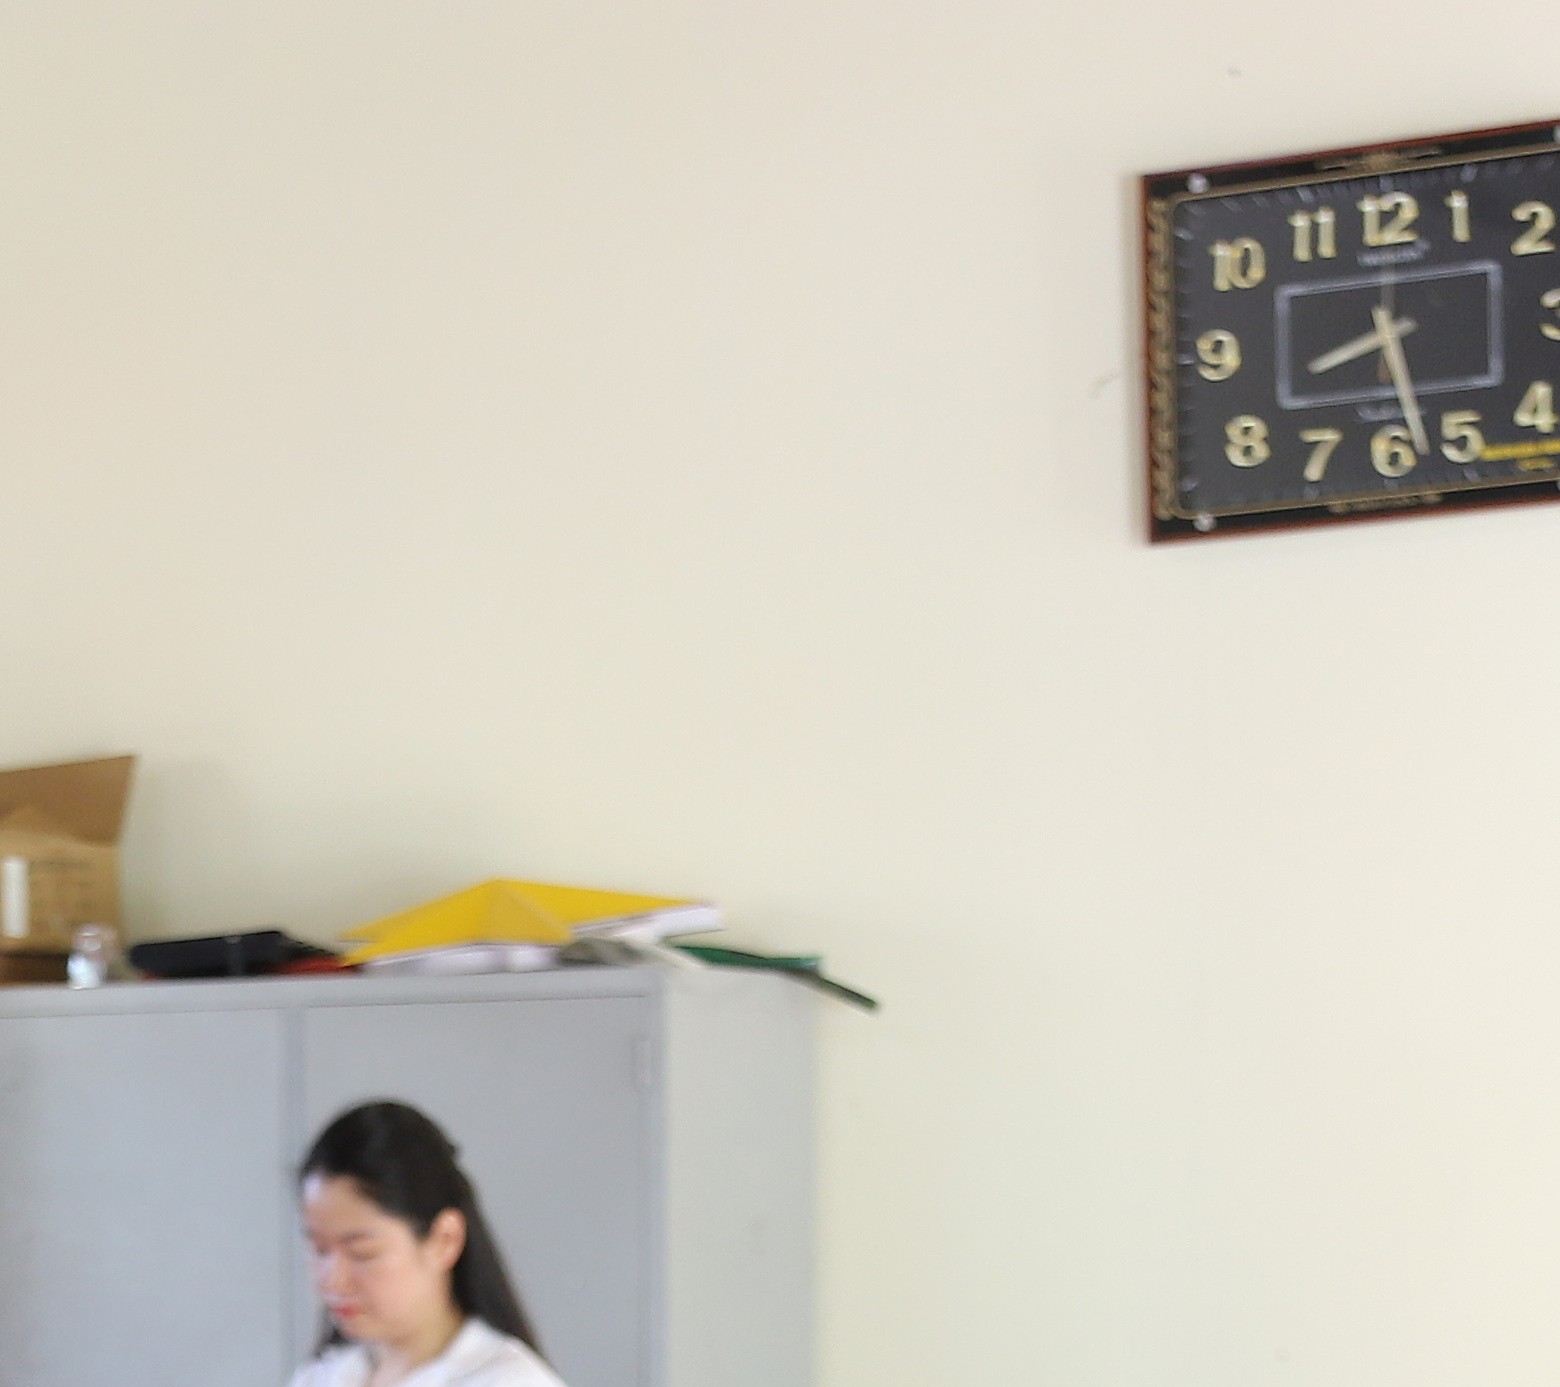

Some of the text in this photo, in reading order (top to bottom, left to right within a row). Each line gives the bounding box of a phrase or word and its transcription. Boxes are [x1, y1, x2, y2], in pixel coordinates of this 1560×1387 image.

[1288, 205, 1338, 263] 11
[1356, 190, 1420, 247] 12
[1444, 189, 1472, 243] 1
[1509, 200, 1557, 257] 2
[1212, 236, 1268, 292] 10
[1194, 328, 1243, 382] 9
[1513, 380, 1560, 434] 4
[1223, 413, 1271, 468] 8
[1298, 427, 1344, 483] 7
[1369, 424, 1418, 478] 6
[1440, 409, 1486, 464] 5
